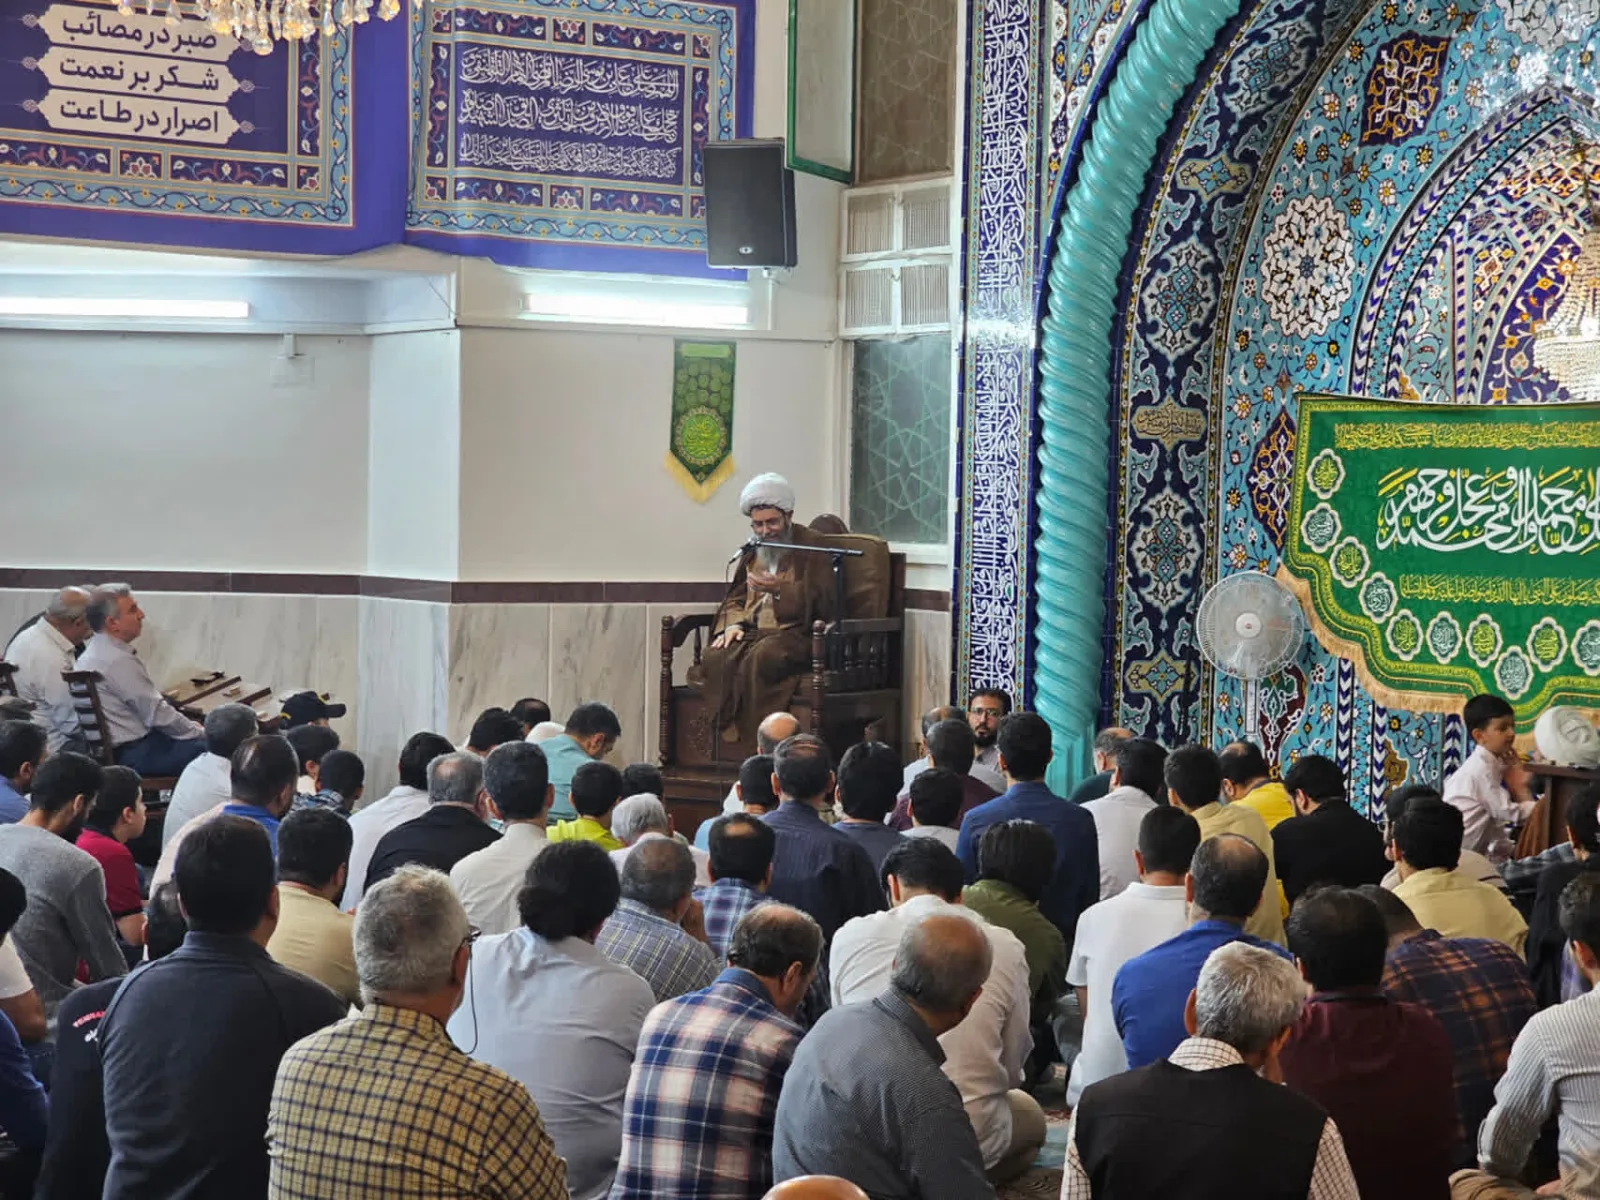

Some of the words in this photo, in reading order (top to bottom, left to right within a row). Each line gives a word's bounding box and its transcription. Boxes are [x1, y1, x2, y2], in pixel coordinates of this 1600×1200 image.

[62, 11, 143, 42] مصائب
[144, 27, 170, 49] در
[171, 33, 217, 54] صبر
[60, 57, 124, 81] نعمت
[128, 69, 150, 91] بر
[154, 65, 220, 93] شکر
[60, 99, 132, 124] طاعت
[134, 108, 159, 132] در
[161, 107, 219, 136] اصرار
